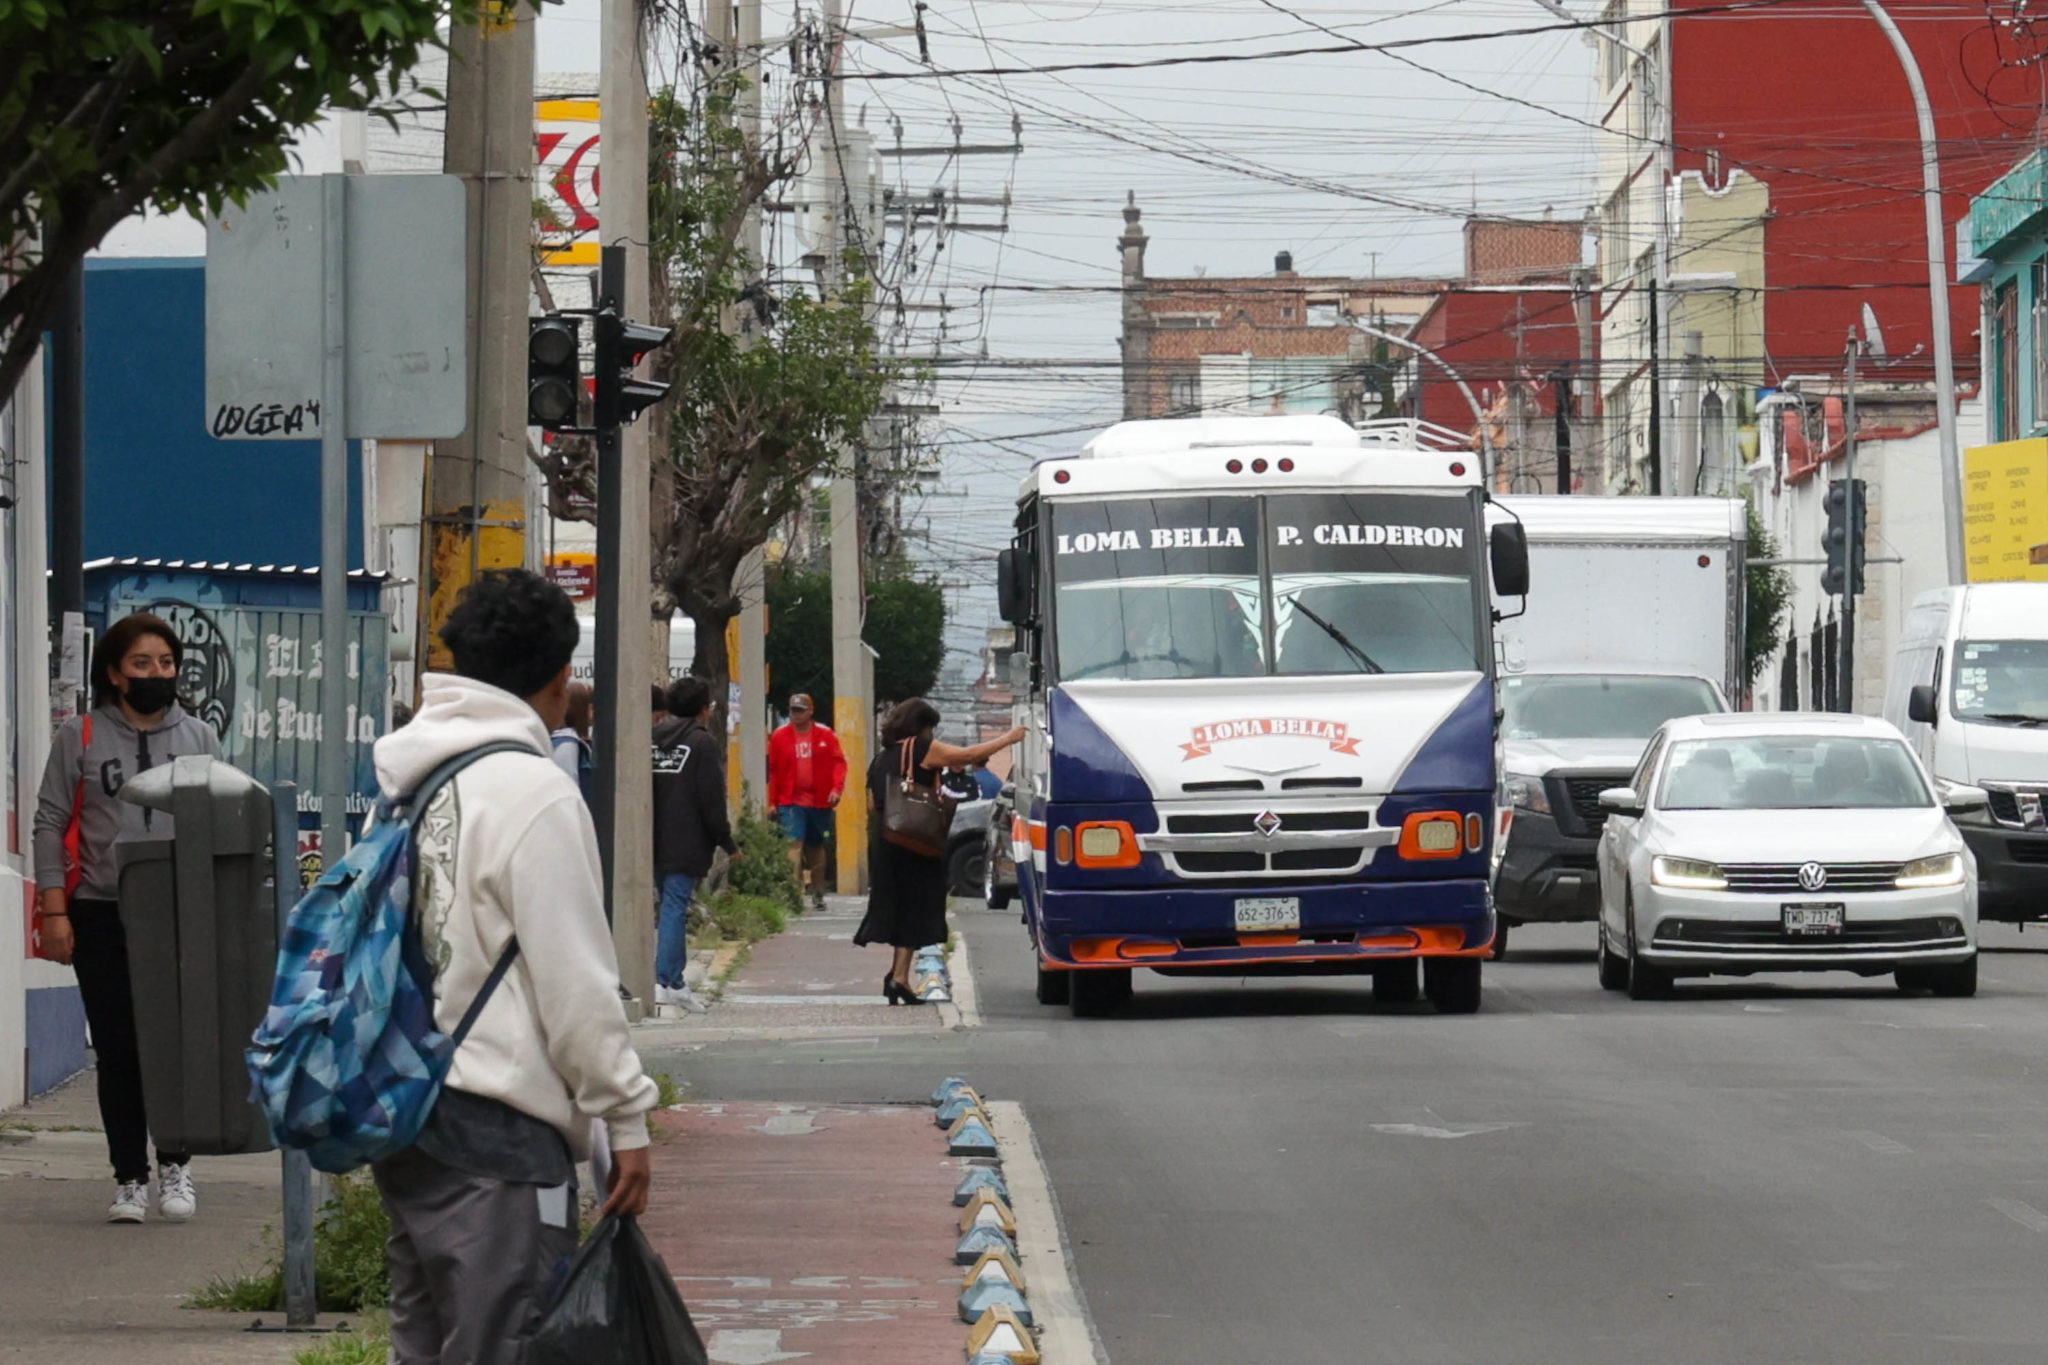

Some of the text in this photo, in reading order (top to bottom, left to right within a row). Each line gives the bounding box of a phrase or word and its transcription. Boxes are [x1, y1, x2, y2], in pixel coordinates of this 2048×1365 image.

[1057, 527, 1245, 554] LOMA BELLA
[1277, 524, 1464, 548] P. CALDERON
[1203, 718, 1337, 742] LOMA BELLA
[1237, 905, 1297, 922] 652-376-S
